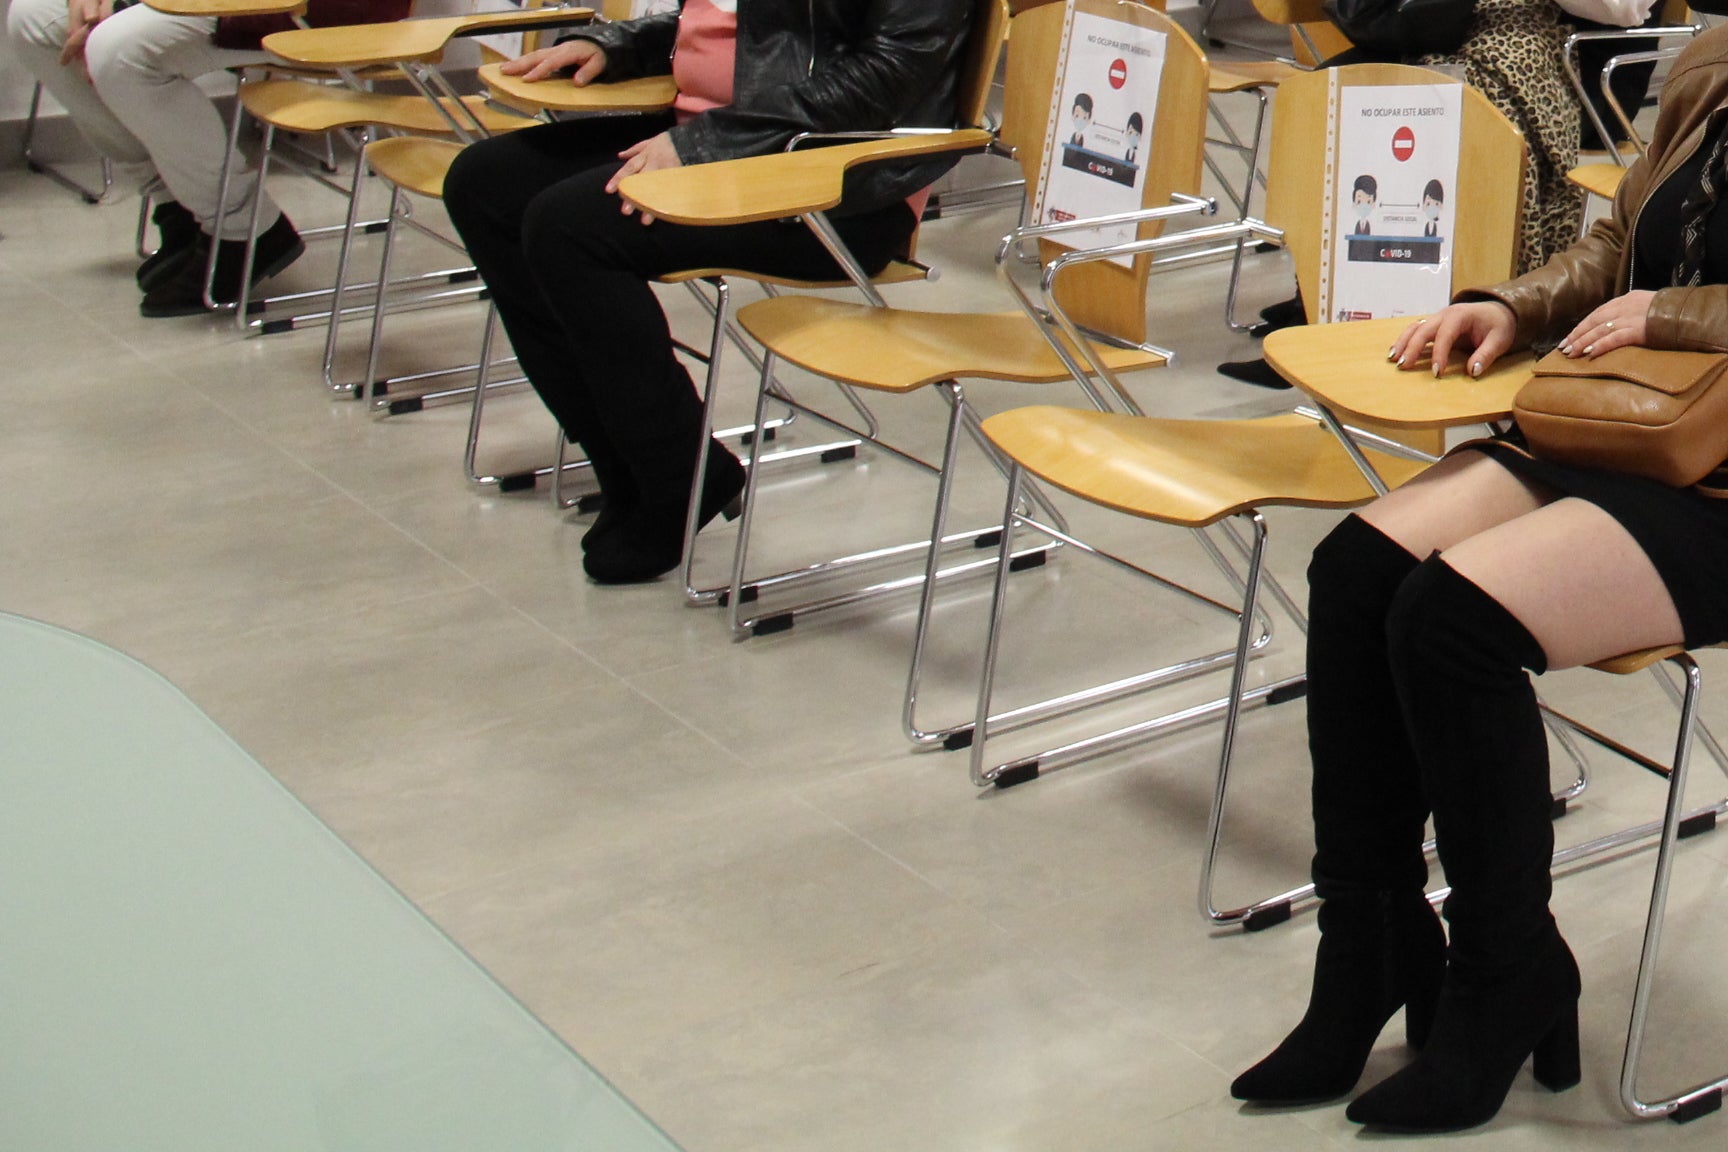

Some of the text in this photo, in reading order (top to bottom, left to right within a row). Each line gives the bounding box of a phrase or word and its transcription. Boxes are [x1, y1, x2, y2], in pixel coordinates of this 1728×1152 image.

[1361, 106, 1444, 117] NO OCUPAR ESTE ASIENTO
